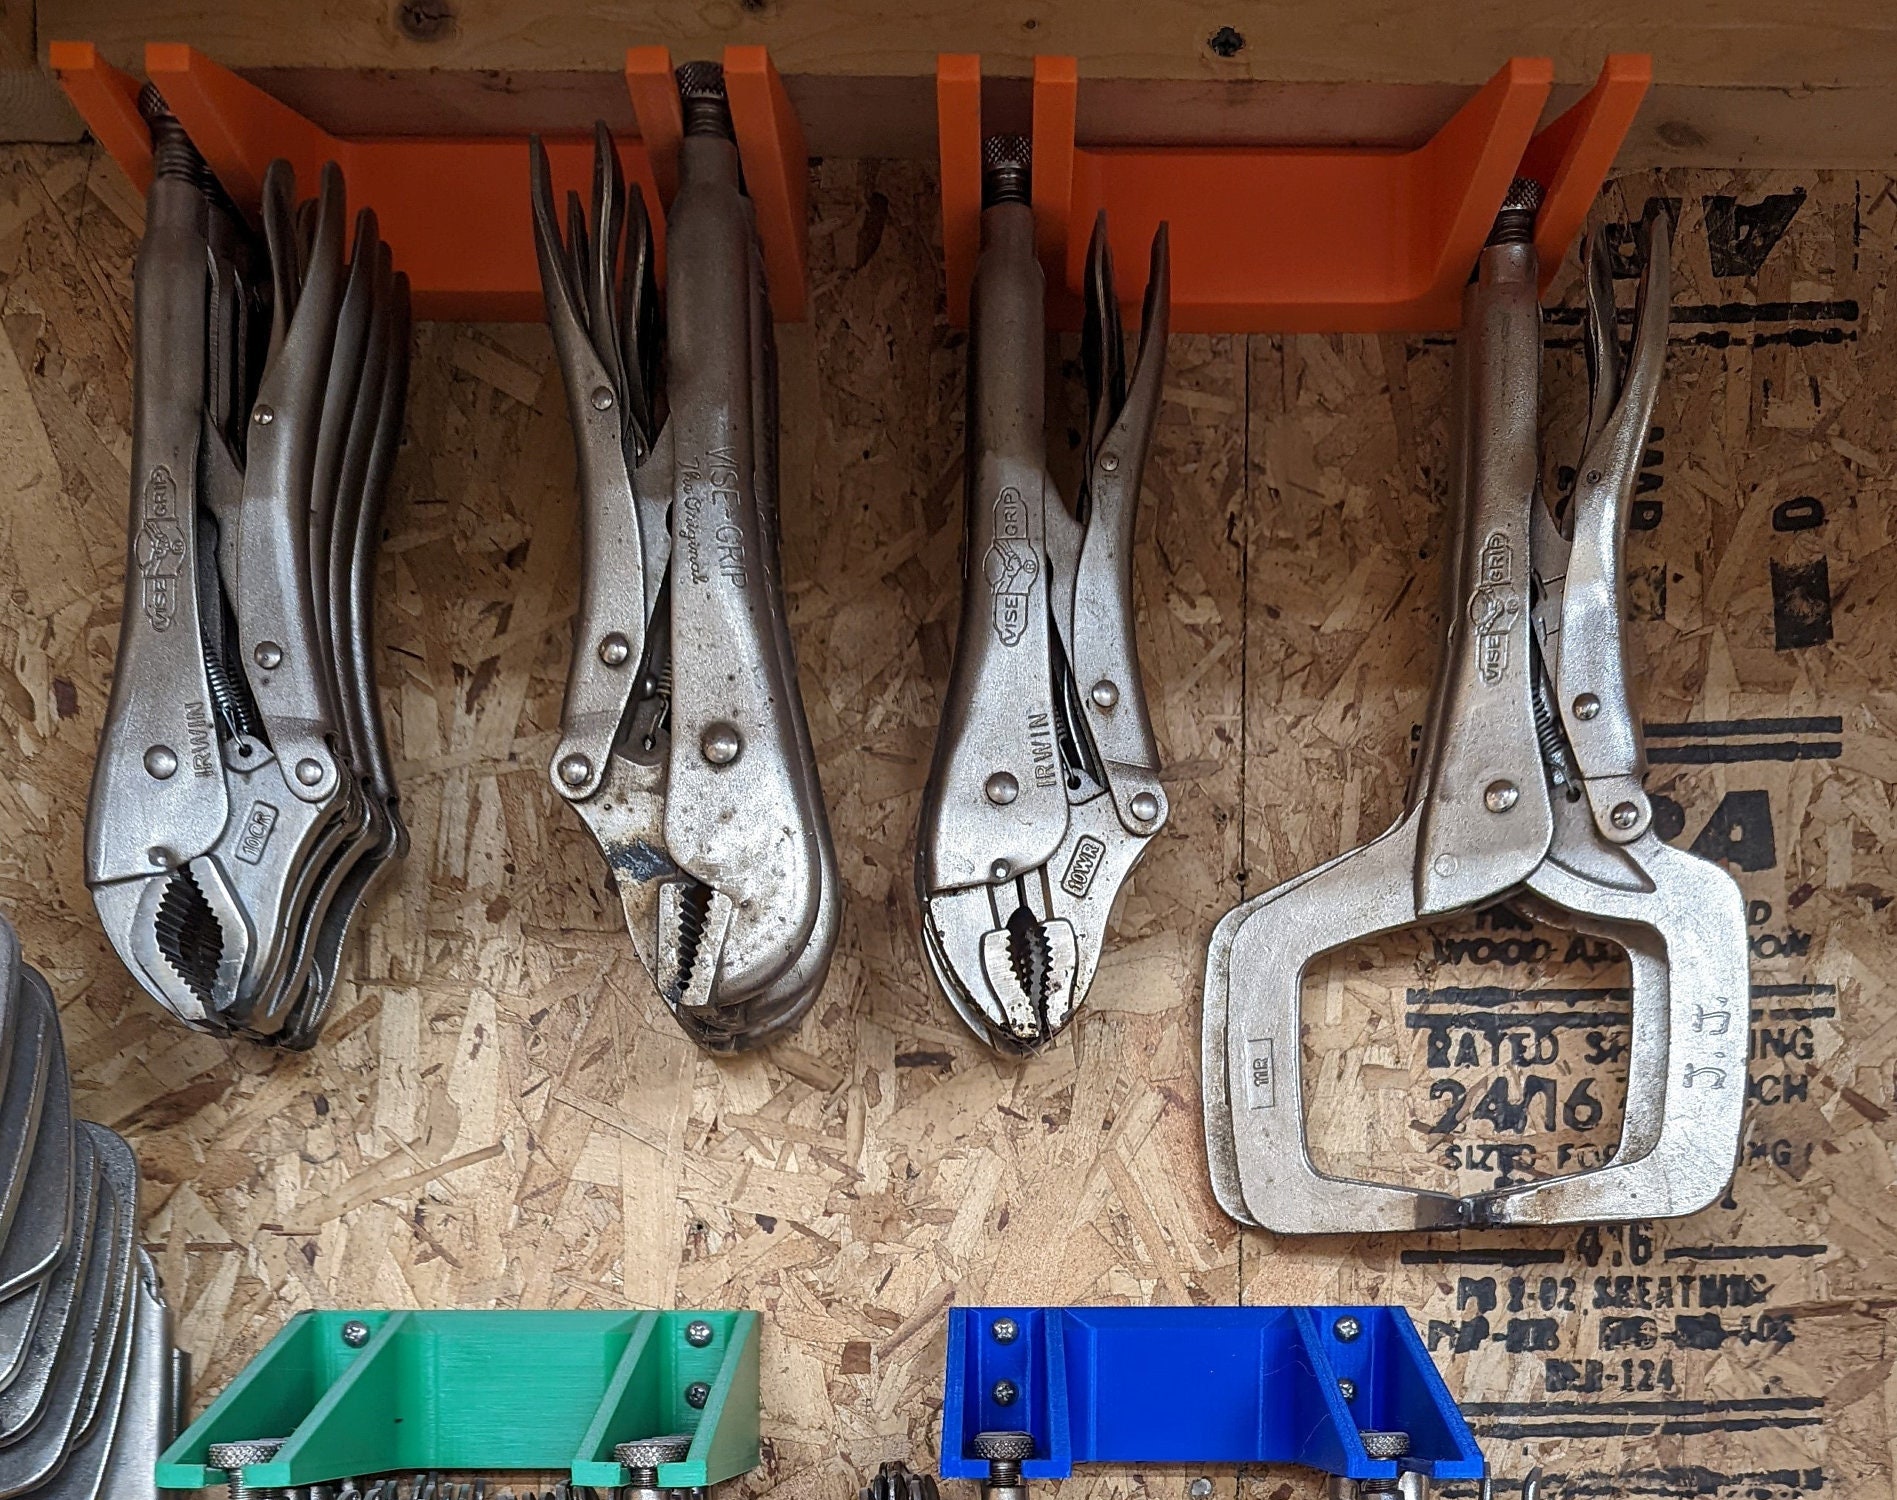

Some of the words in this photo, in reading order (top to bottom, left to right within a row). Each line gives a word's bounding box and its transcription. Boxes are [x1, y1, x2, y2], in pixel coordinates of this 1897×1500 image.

[152, 470, 168, 516] GRIP
[678, 455, 701, 495] The
[705, 446, 749, 590] VISE-GRIP
[1004, 493, 1019, 536] GRIP
[680, 496, 709, 586] Original
[1489, 536, 1505, 582] GRIP
[152, 579, 168, 628] VISE
[1004, 597, 1019, 640] VISE
[1486, 634, 1501, 684] VISE
[185, 702, 213, 779] IRWIN
[1027, 713, 1057, 788] IRWIN
[243, 811, 271, 857] 10CR
[1068, 842, 1100, 891] 10WR
[1427, 1030, 1560, 1069] RATED
